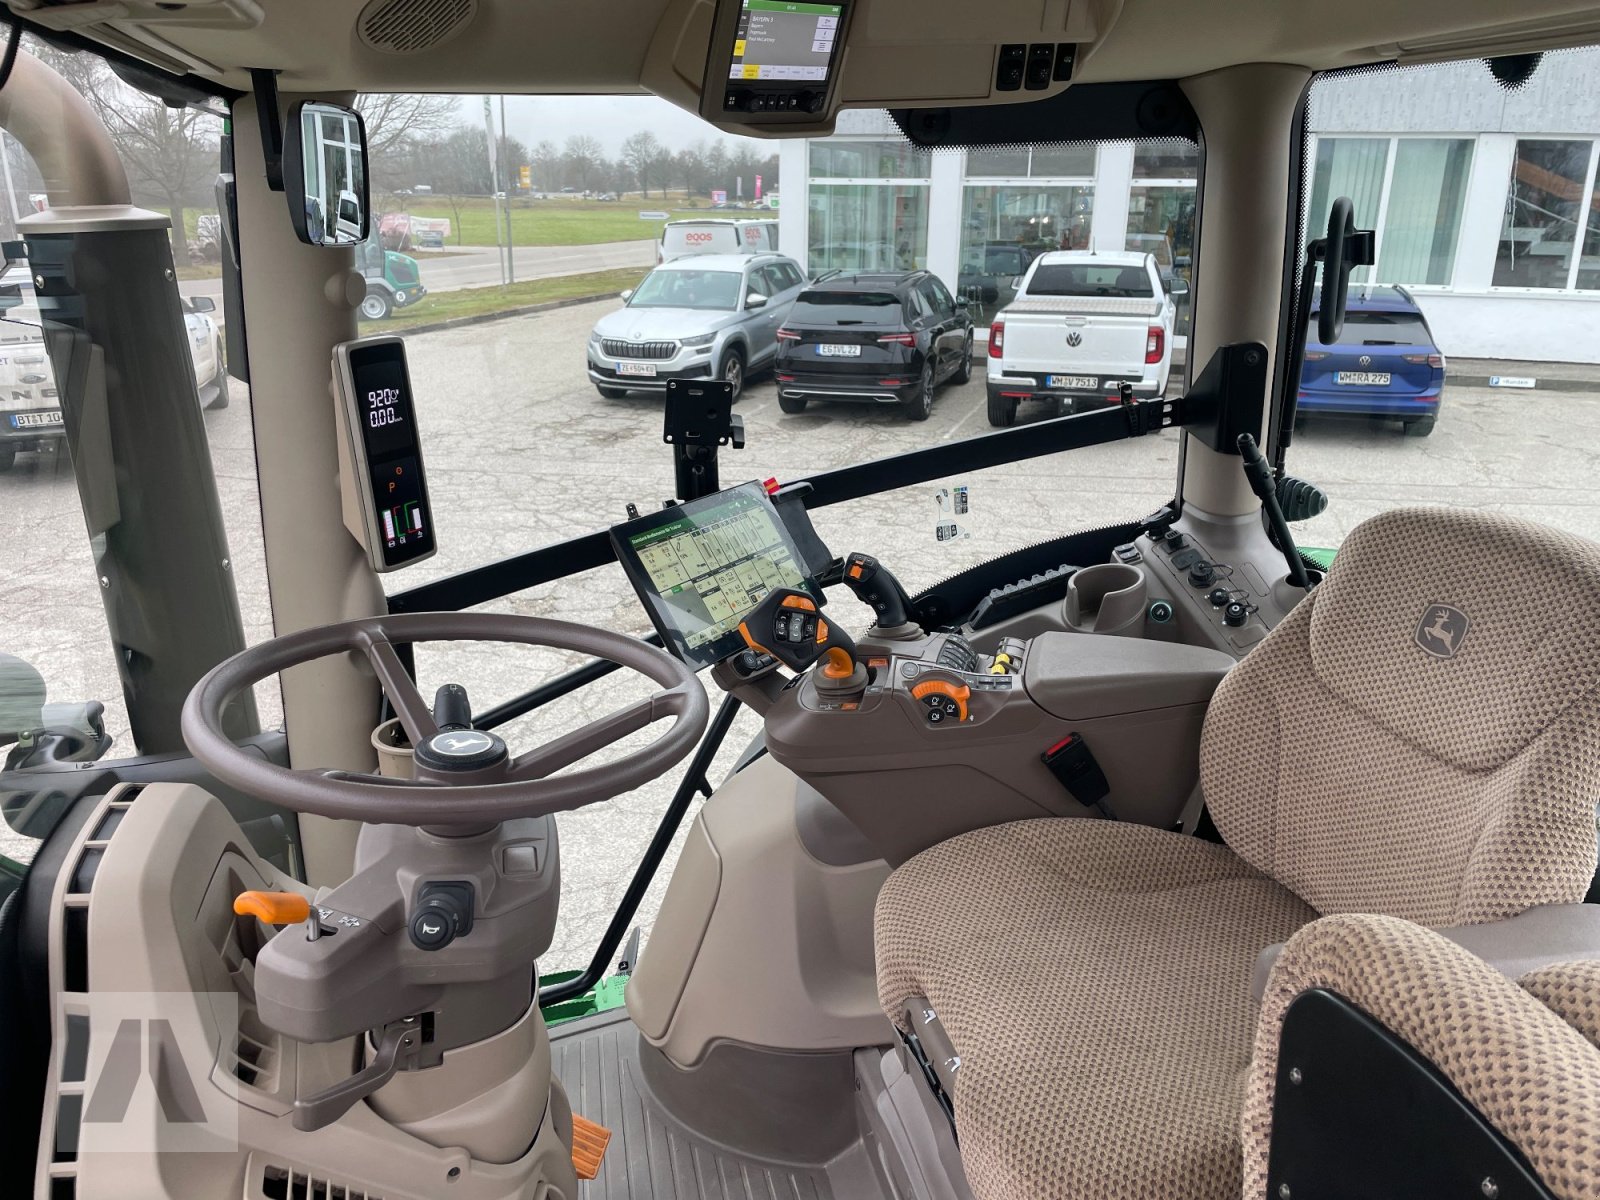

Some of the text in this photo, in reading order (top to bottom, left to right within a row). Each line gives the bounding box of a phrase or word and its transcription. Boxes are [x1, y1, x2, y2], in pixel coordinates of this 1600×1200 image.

[847, 345, 858, 354] 22
[1052, 377, 1063, 385] WM
[1075, 377, 1097, 388] 7513
[1338, 373, 1390, 383] WM RA 275
[17, 414, 32, 425] BT
